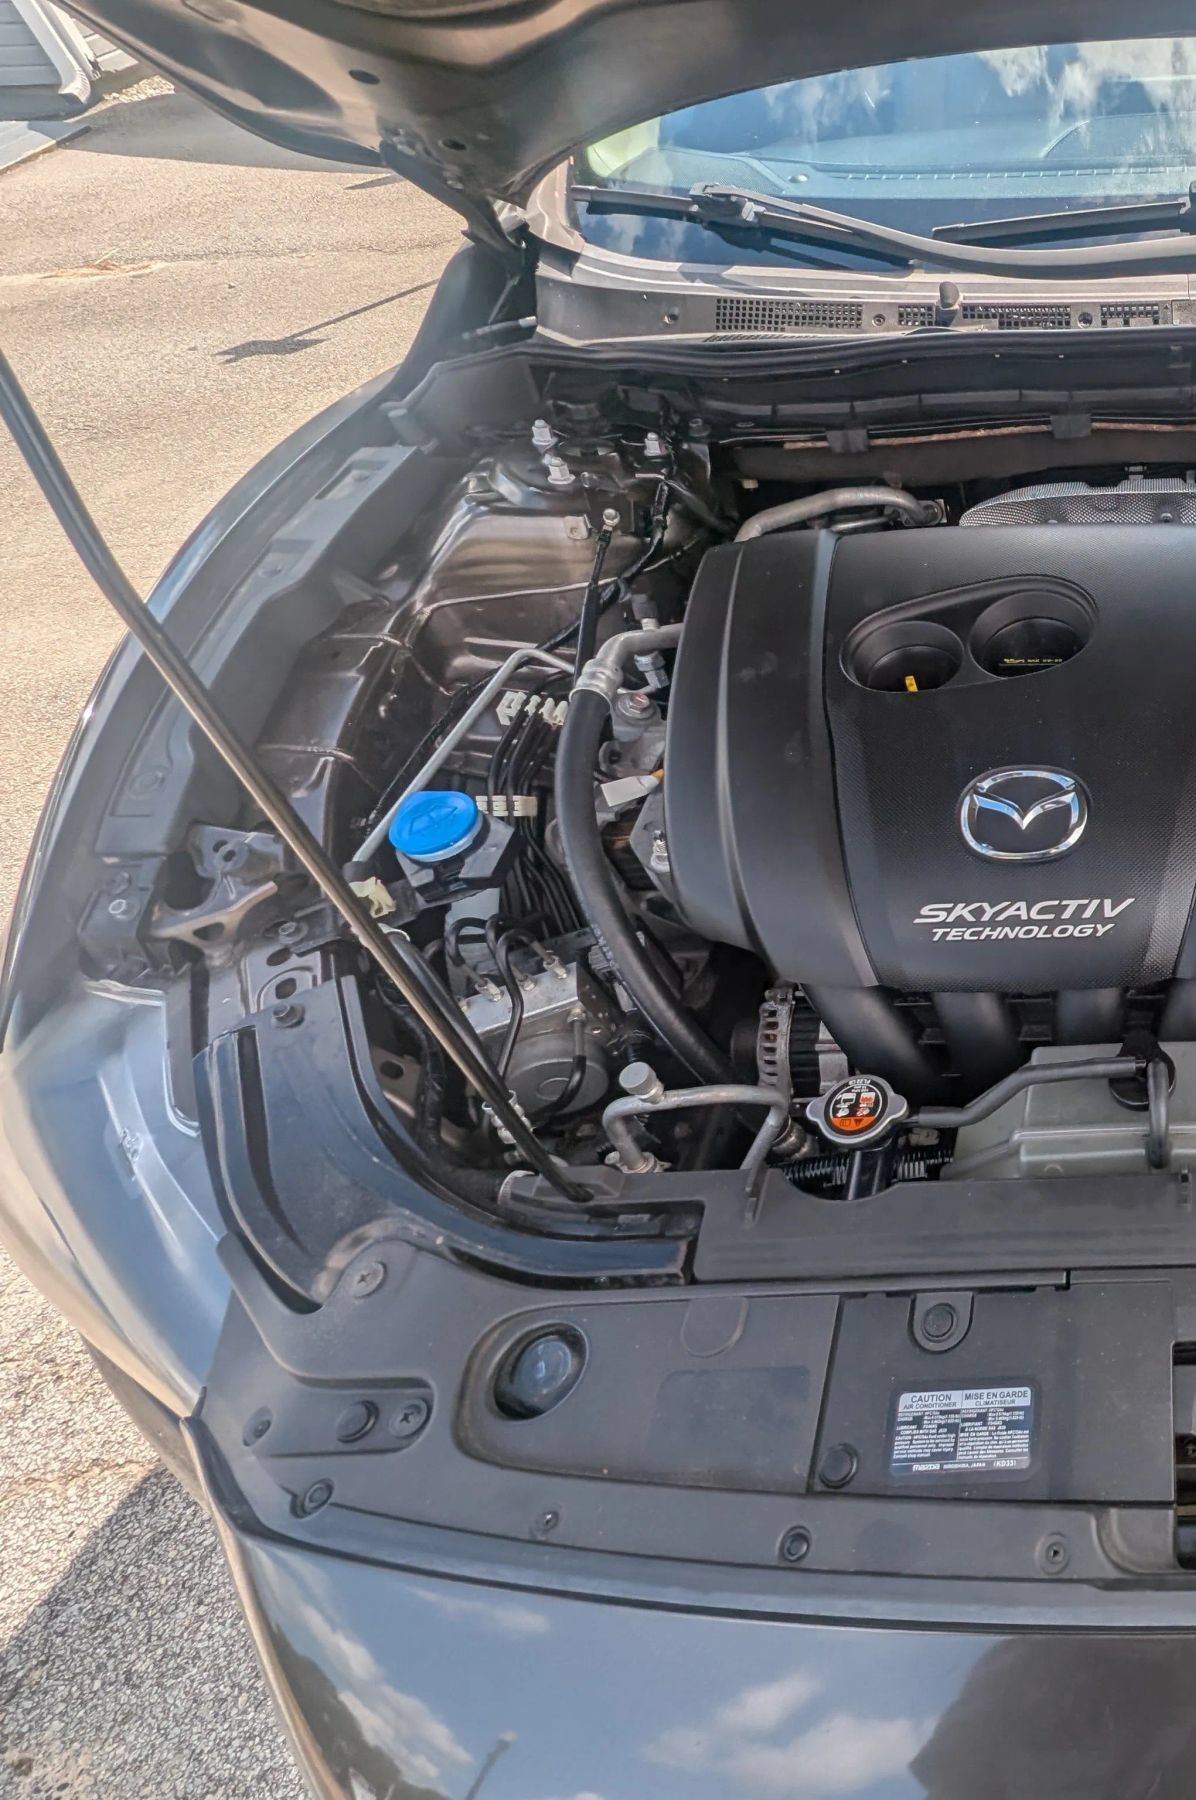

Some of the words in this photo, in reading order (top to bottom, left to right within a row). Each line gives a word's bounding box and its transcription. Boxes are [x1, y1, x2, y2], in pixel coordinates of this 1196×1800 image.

[912, 898, 1136, 924] SKYACTIV
[932, 923, 1115, 941] TECHNOLOGY
[910, 1393, 952, 1404] CAUTION
[964, 1392, 985, 1401] MISE
[986, 1391, 998, 1400] EN
[999, 1390, 1029, 1399] GARDE
[914, 1402, 957, 1410] CONDITIONER
[974, 1399, 1016, 1407] CLIMATISEUR
